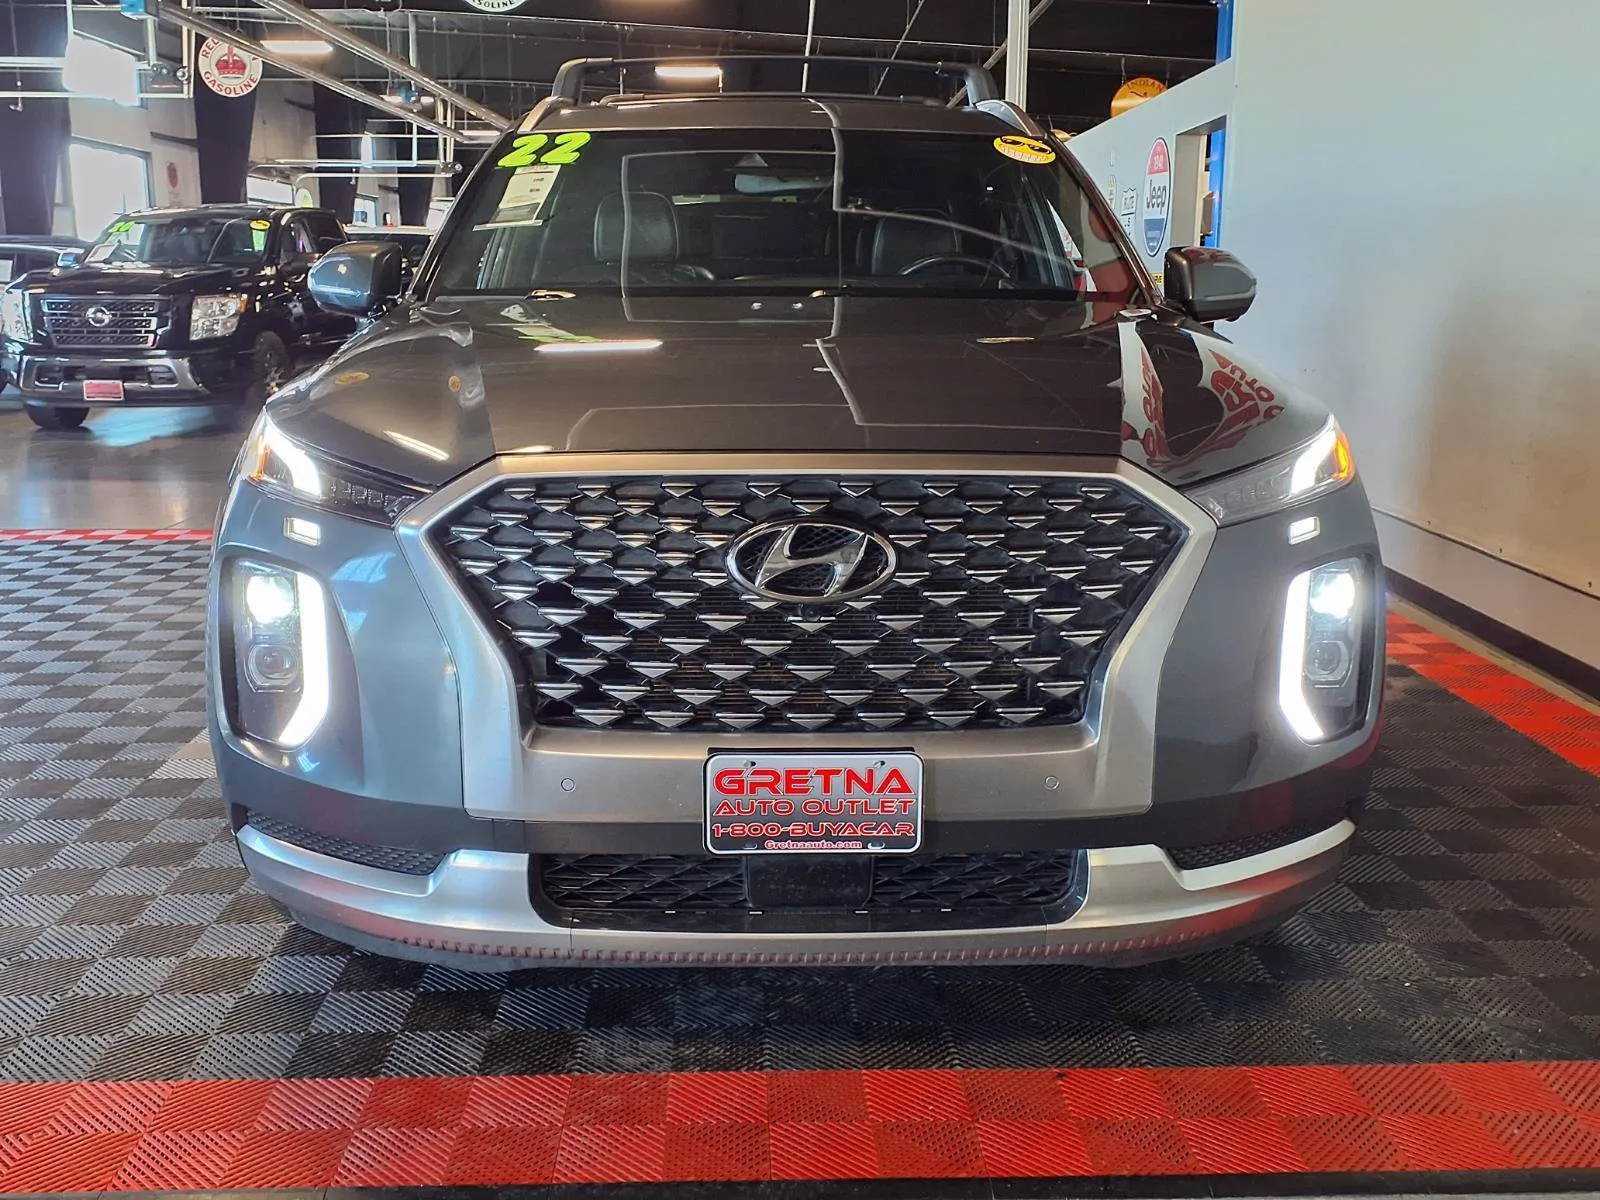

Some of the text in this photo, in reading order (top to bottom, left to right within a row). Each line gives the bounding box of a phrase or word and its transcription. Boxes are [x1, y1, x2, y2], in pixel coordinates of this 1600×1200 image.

[203, 71, 258, 95] GASOLINE
[497, 131, 592, 167] 22
[1146, 179, 1167, 215] Jeep
[713, 767, 915, 796] GRETNA
[712, 799, 916, 816] AUTO OUTLET
[712, 822, 915, 838] 1-800-BUYACAR
[764, 840, 863, 850] Gretnaauto.com
